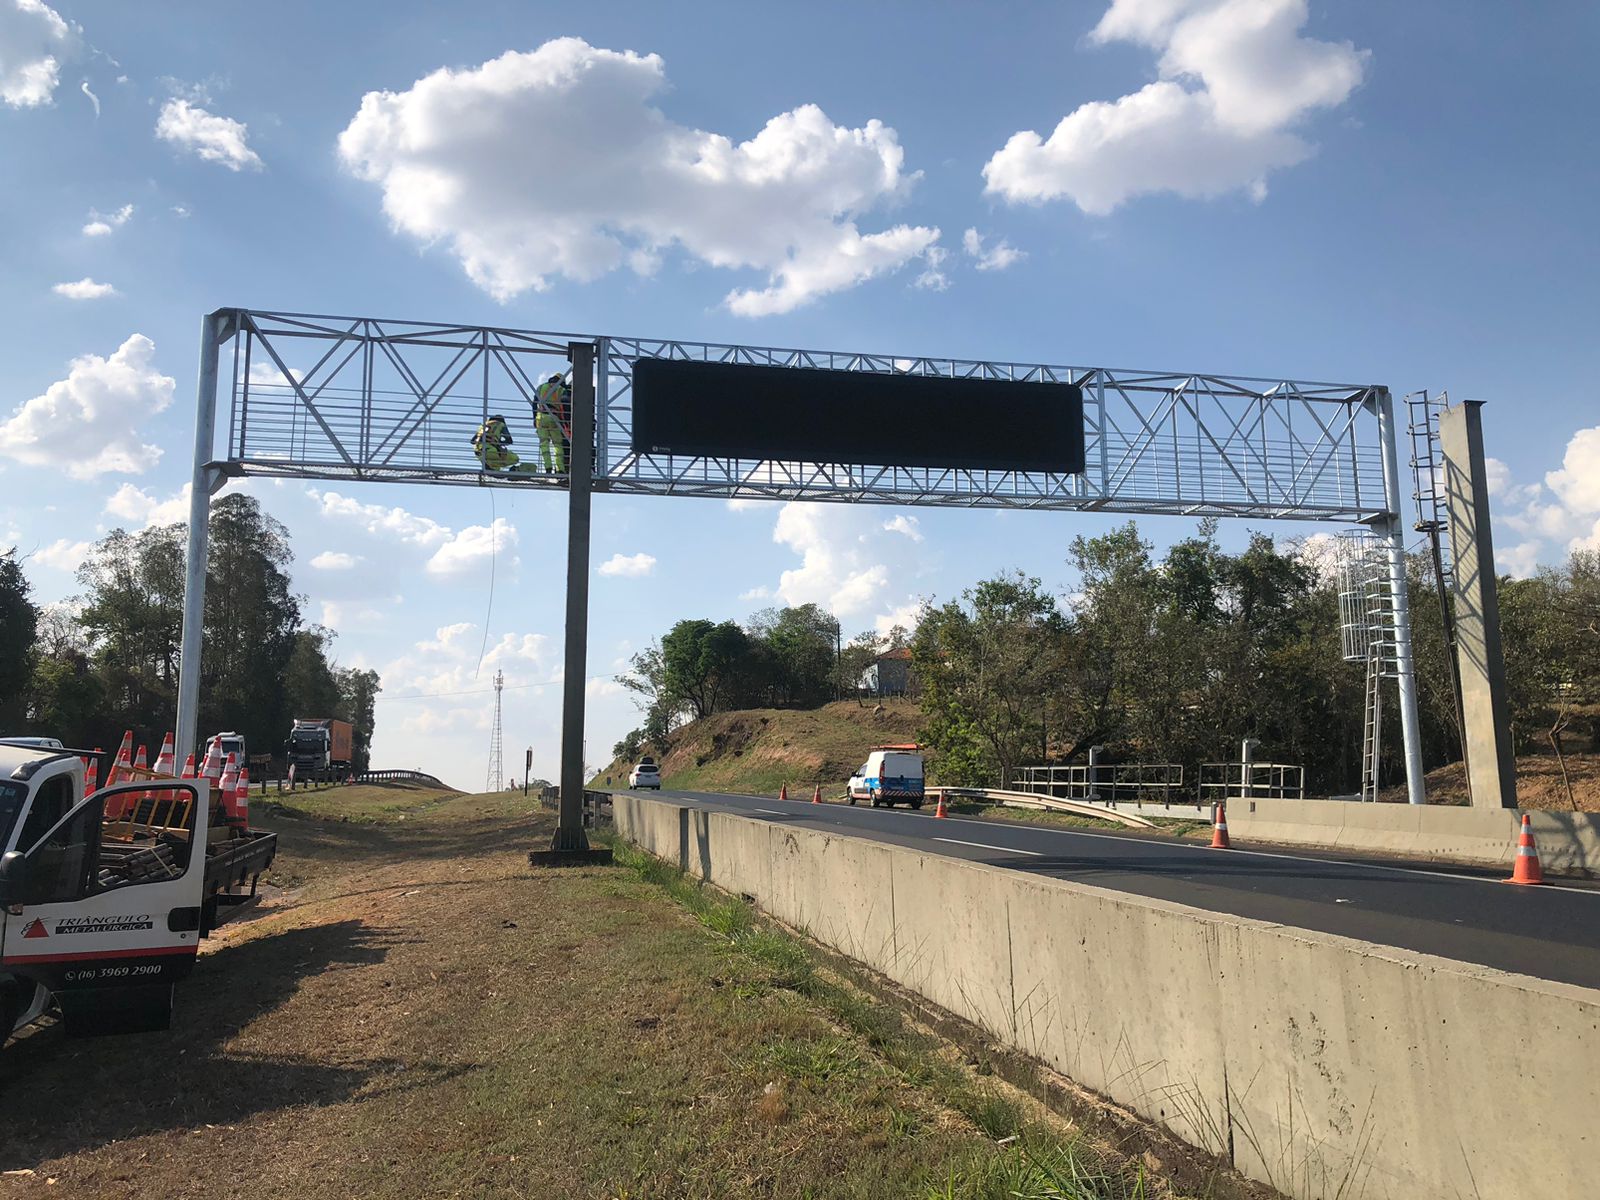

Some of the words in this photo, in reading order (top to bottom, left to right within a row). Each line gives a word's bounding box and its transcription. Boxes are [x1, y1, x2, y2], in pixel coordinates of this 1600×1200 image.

[77, 969, 97, 981] (16)
[100, 966, 129, 979] 3969
[131, 964, 162, 977] 2900
